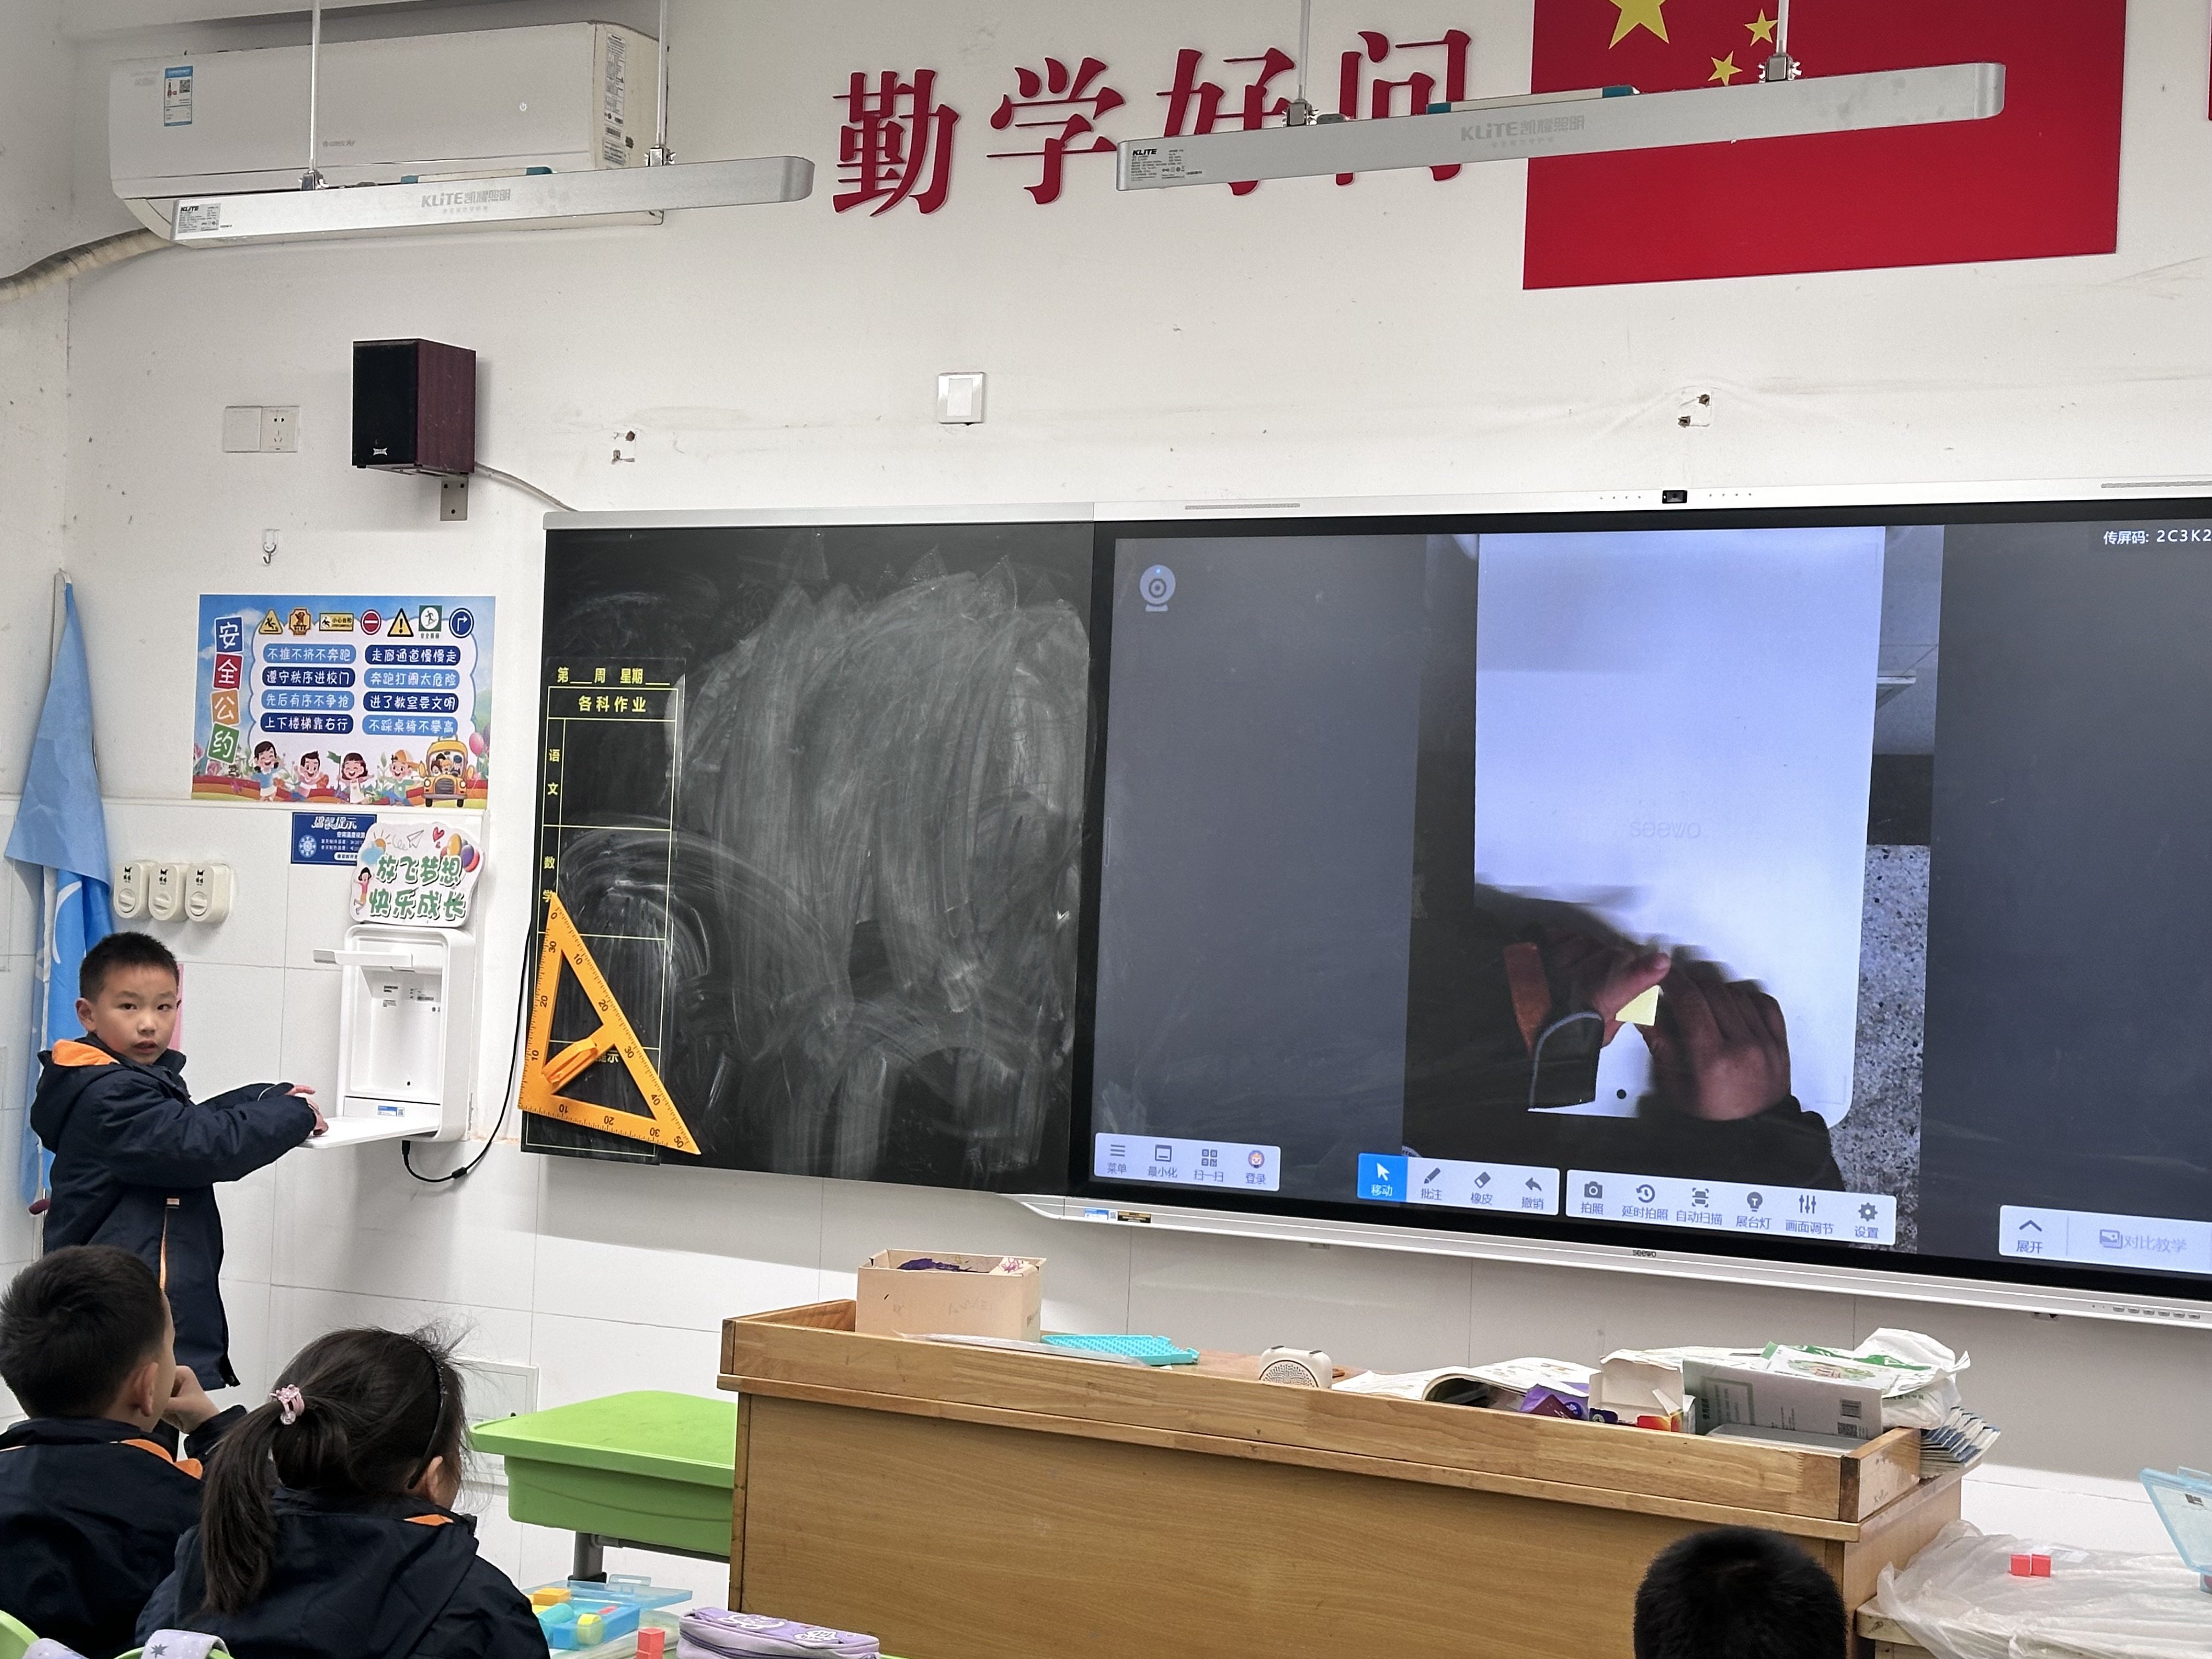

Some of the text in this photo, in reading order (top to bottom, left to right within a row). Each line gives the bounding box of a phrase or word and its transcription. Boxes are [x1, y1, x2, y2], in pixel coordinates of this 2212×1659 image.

[832, 29, 1471, 217] 勤学好问
[2156, 529, 2212, 542] 2C3K2
[267, 647, 351, 662] 不推不挤不奔跑
[371, 648, 457, 663] 走廊通道慢慢走
[266, 669, 349, 685] 遵守秩序进校门
[370, 672, 456, 687] 奔跑打闹太危险
[557, 667, 644, 685] 第 周 星期
[213, 623, 240, 758] 安全公约
[266, 693, 349, 708] 先后有序不争抢
[370, 695, 455, 710] 进了教室要文明
[578, 696, 646, 713] 各科作业
[265, 715, 348, 731] 上下楼梯靠右行
[369, 718, 454, 733] 不踩桌椅不攀高
[548, 749, 560, 795] 语文
[376, 856, 462, 885] 放飞梦想
[369, 889, 466, 921] 快乐成长
[549, 940, 557, 953] 30
[573, 953, 583, 965] 10
[540, 995, 548, 1008] 20
[599, 1000, 608, 1012] 20
[532, 1050, 539, 1062] 10
[624, 1046, 634, 1059] 30
[651, 1094, 661, 1105] 40
[559, 1104, 568, 1114] 10
[603, 1115, 614, 1125] 20
[650, 1127, 660, 1138] 30
[674, 1136, 684, 1148] 50
[1107, 1162, 1266, 1185] 菜单 最小化 扫一扫 登录
[1371, 1184, 1544, 1210] 移动 批注 橡皮 撤销
[1580, 1201, 1879, 1239] 拍照 延时拍照 自动扫描 展台灯 画面调节 设置
[2016, 1240, 2043, 1254] 展开
[2124, 1235, 2187, 1253] 对比教学
